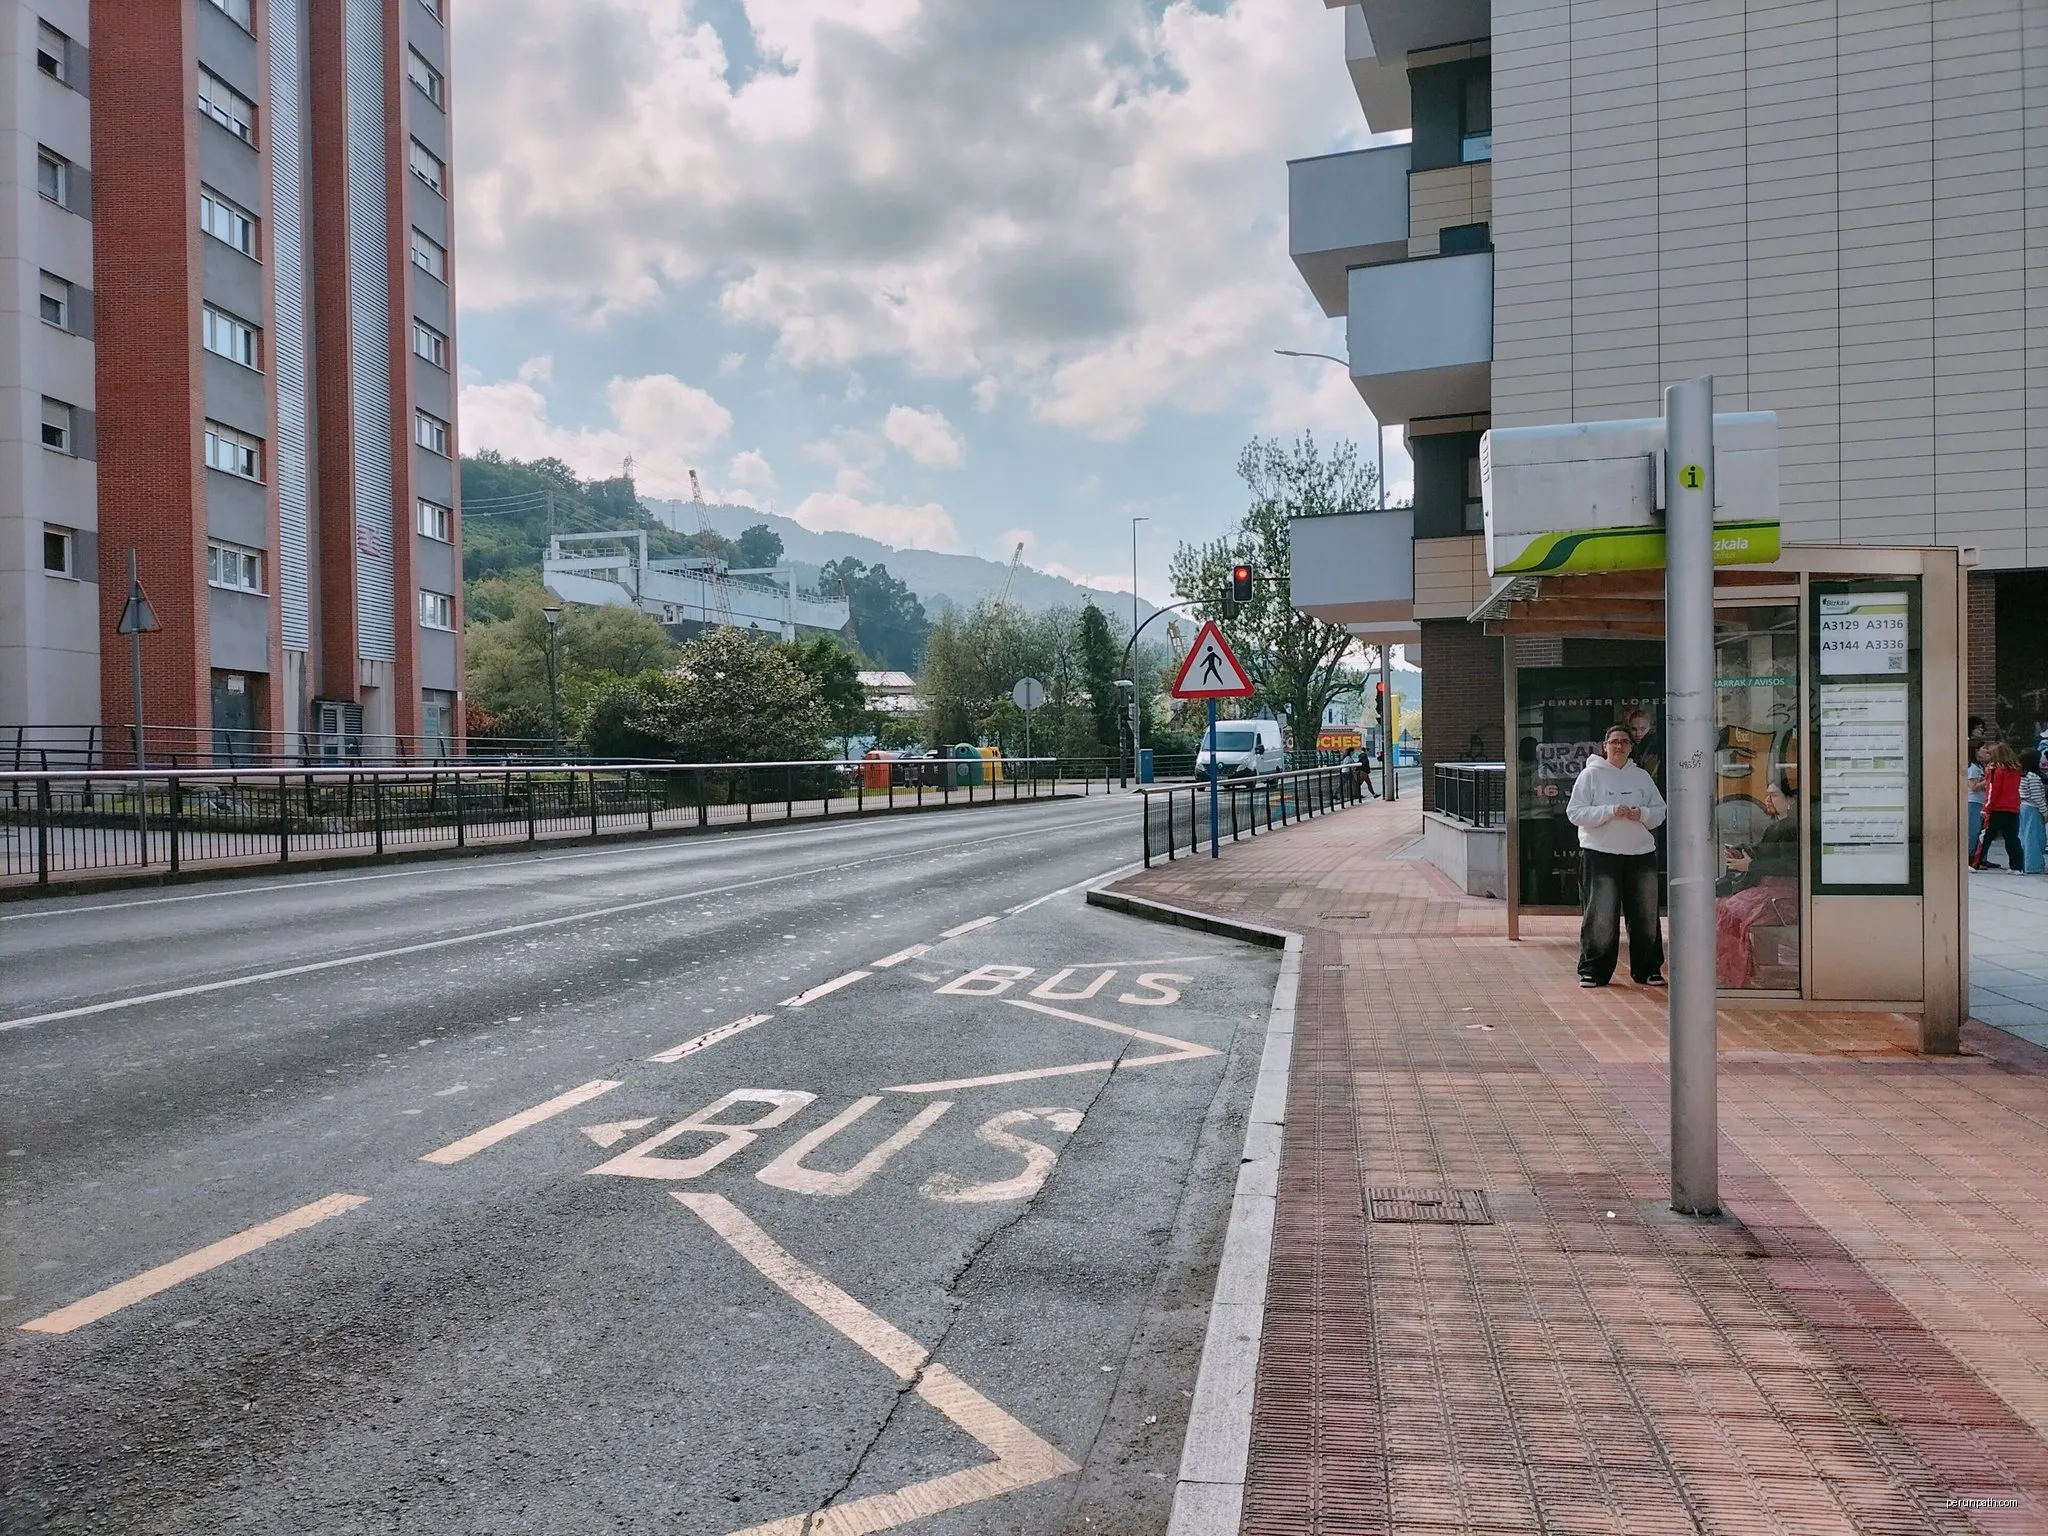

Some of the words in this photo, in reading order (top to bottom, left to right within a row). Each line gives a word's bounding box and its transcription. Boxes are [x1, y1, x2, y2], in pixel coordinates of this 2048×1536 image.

[1822, 620, 1859, 631] A3129
[1866, 619, 1904, 630] A3136
[1822, 640, 1859, 651] A3144
[1865, 639, 1904, 650] A3336
[1754, 678, 1785, 687] AVISOS
[1540, 698, 1613, 707] JENNIFER
[1317, 735, 1361, 748] CHES
[1534, 784, 1559, 798] 16
[933, 964, 1194, 1005] BUS
[583, 1088, 1087, 1202] BUS
